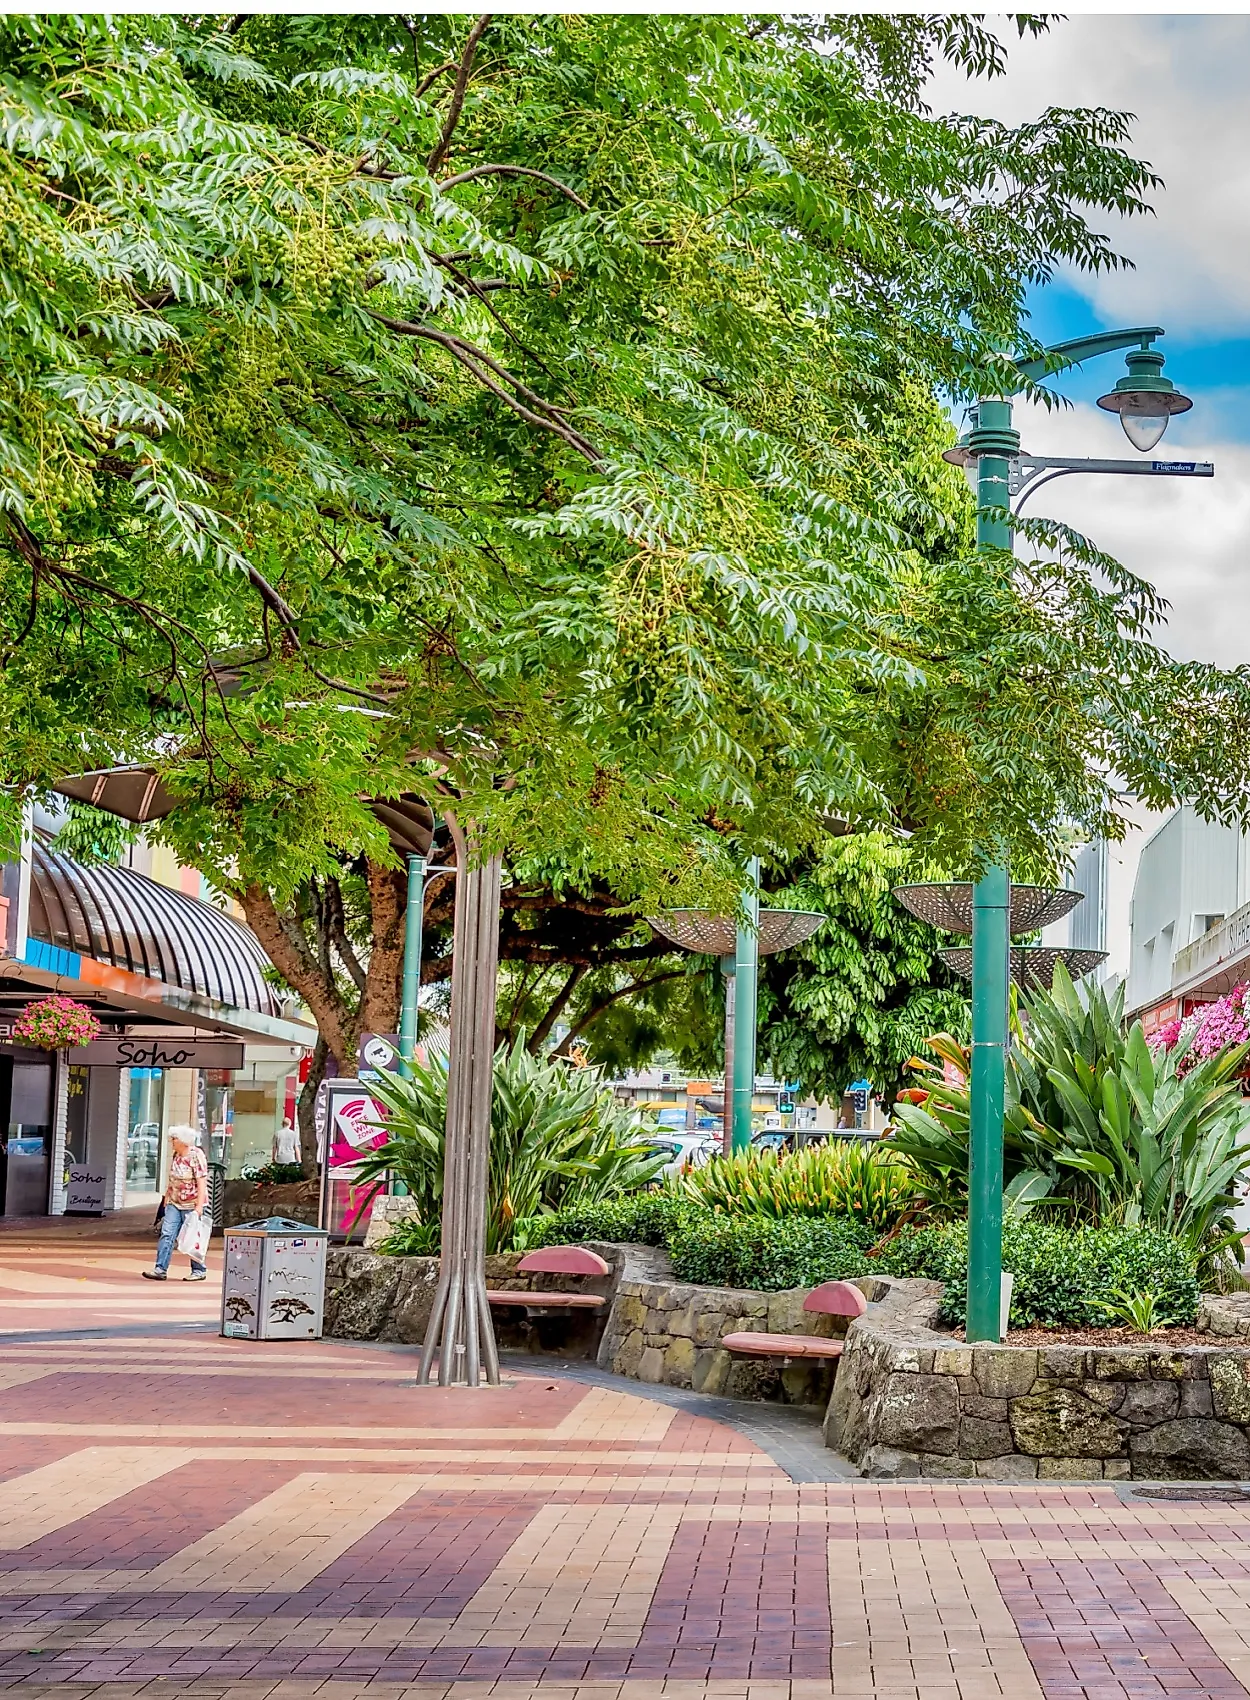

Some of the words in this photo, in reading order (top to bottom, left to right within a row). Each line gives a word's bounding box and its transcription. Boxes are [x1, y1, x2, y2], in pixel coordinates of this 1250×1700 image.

[116, 1042, 195, 1065] Soho
[357, 1127, 374, 1140] ZONE
[70, 1171, 107, 1183] Soho
